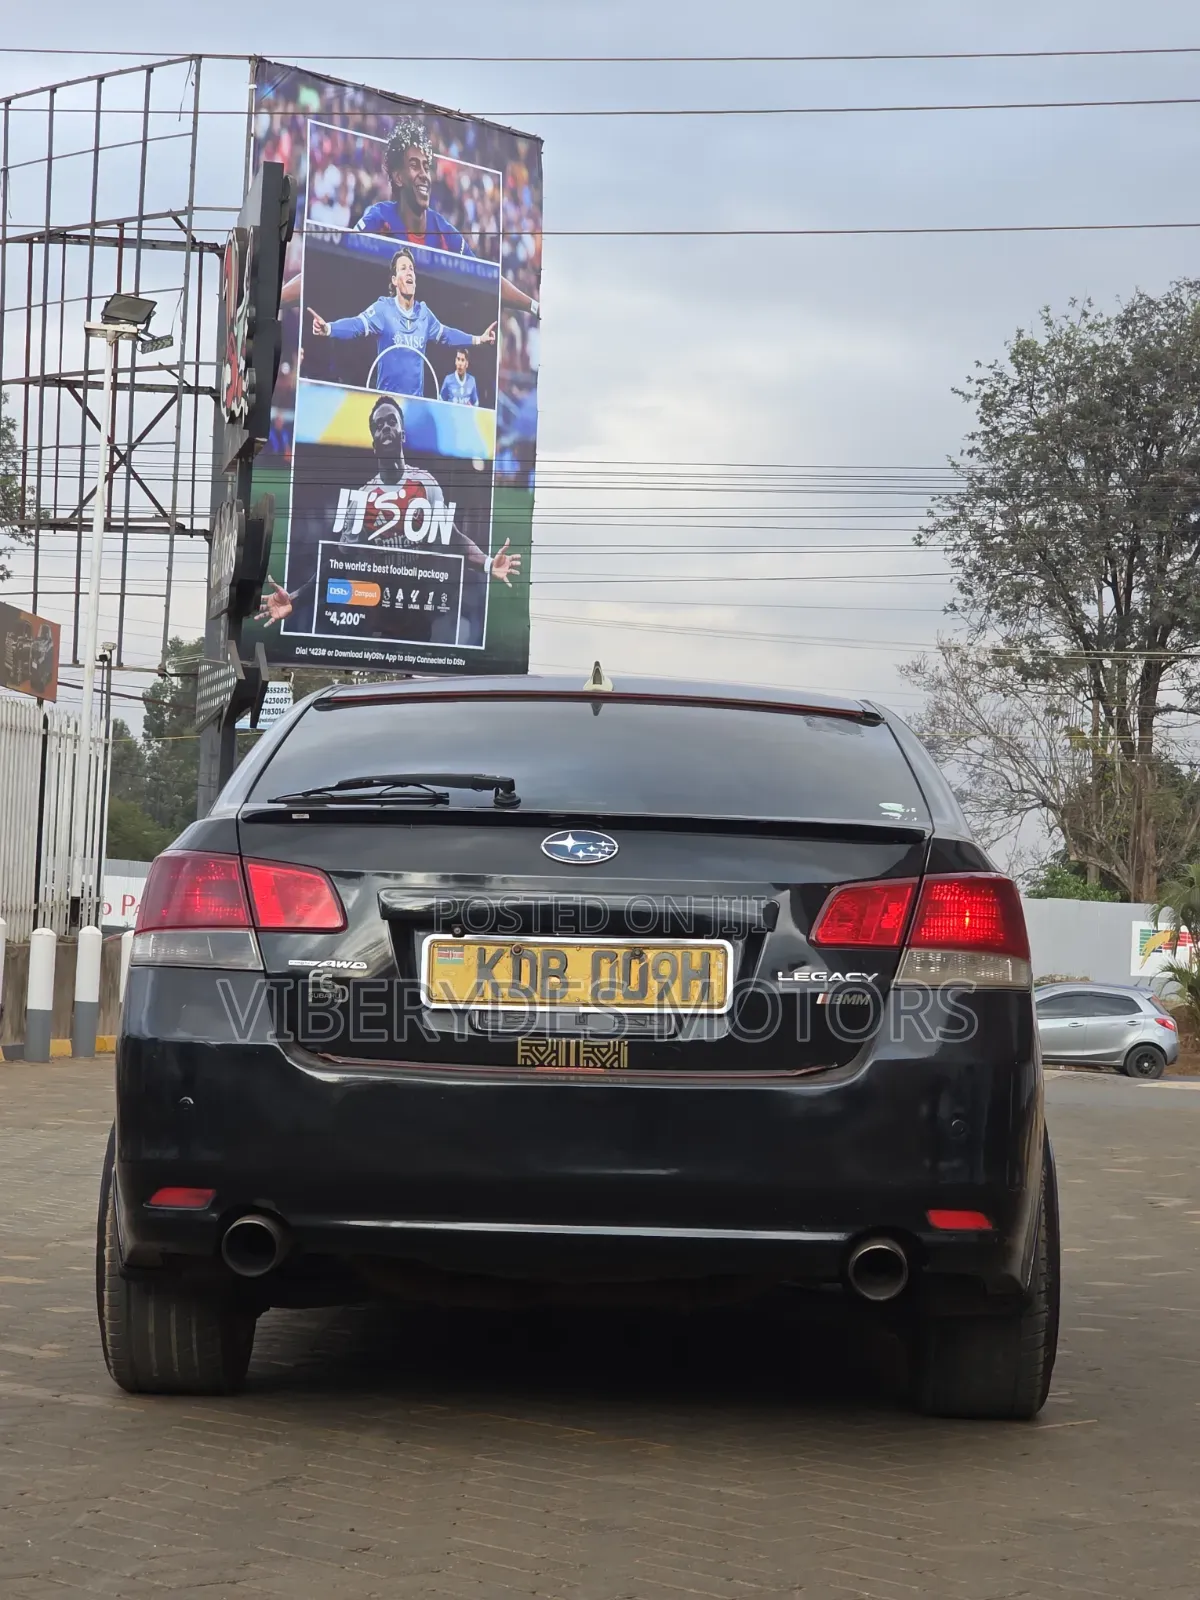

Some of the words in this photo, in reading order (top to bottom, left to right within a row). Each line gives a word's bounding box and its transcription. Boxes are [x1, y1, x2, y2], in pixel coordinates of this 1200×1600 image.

[404, 498, 457, 545] ON
[329, 559, 343, 569] The
[345, 560, 371, 572] world's
[373, 564, 389, 574] best
[390, 565, 417, 577] football
[417, 569, 449, 582] package
[330, 611, 360, 626] 4,200
[295, 646, 308, 655] Dial
[334, 649, 363, 658] Download
[364, 651, 384, 661] MyDStv
[385, 653, 397, 662] App
[404, 655, 416, 664] stay
[417, 655, 446, 665] Connected
[447, 657, 453, 665] to
[453, 658, 465, 666] DStv
[318, 960, 368, 969] AWD
[476, 947, 568, 1000] KDB
[777, 971, 879, 983] LEGACY
